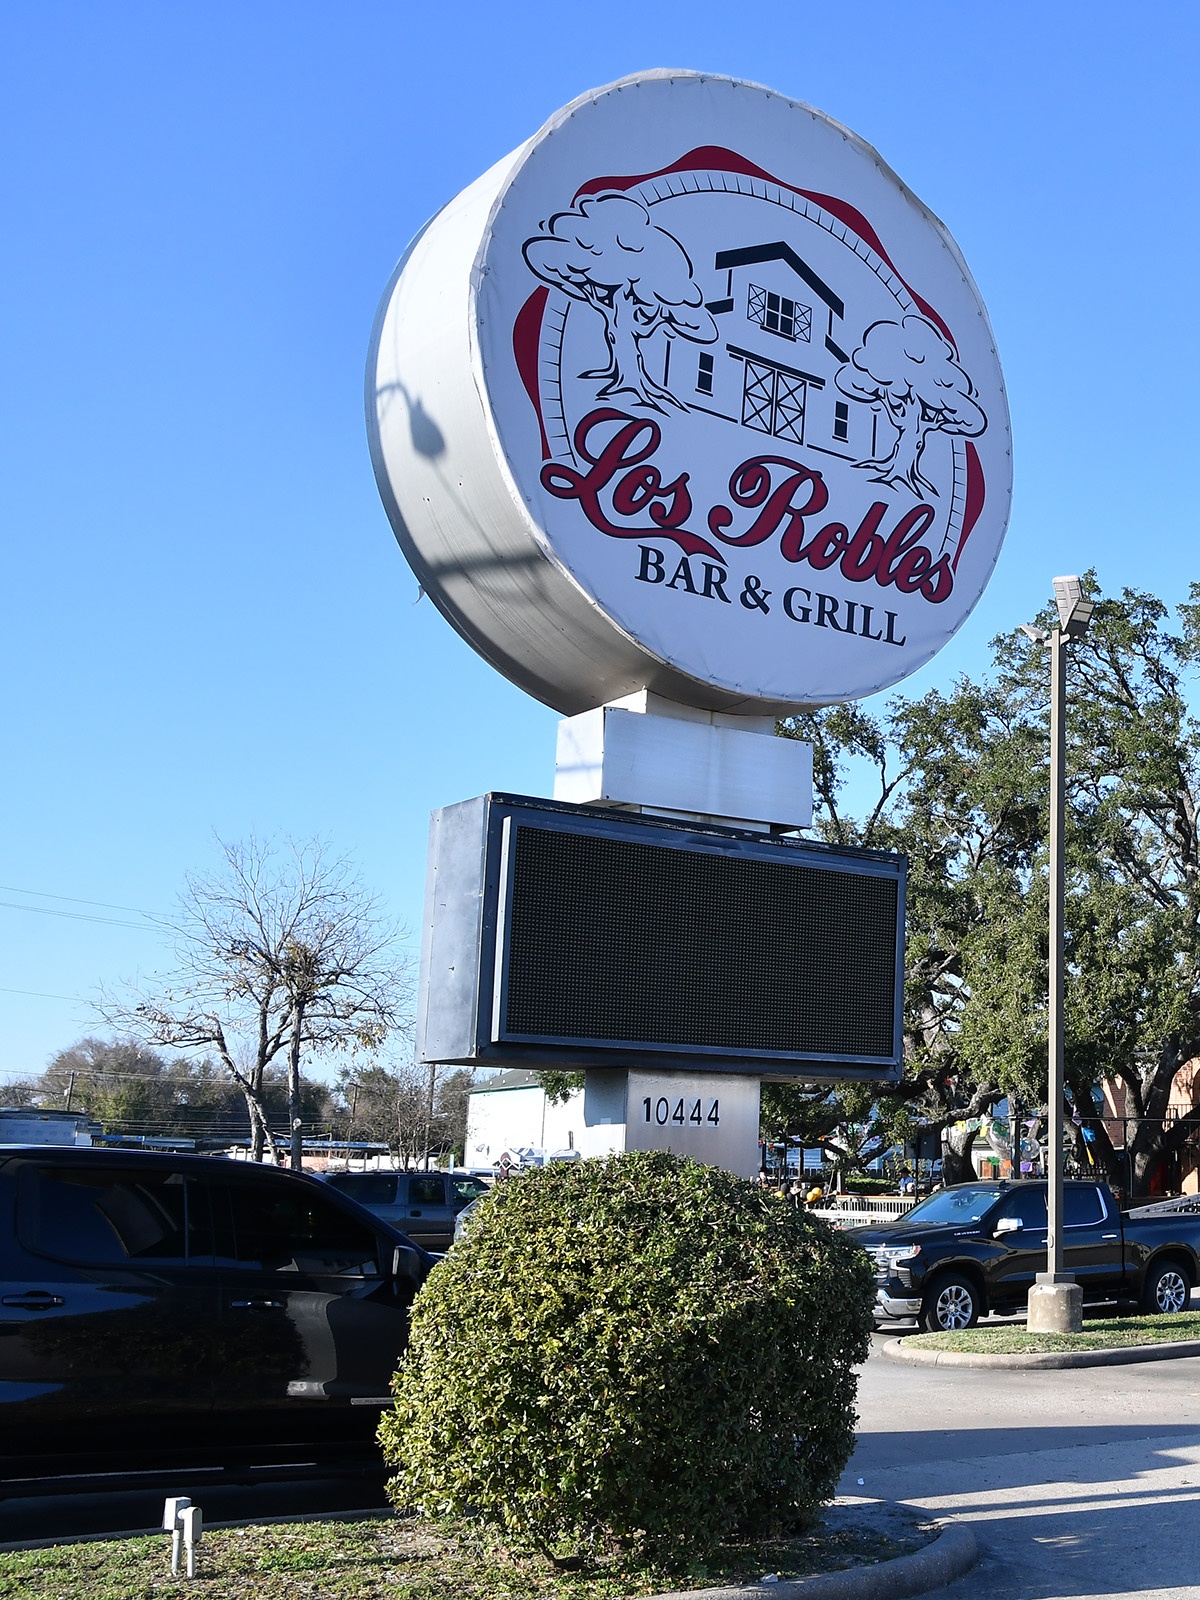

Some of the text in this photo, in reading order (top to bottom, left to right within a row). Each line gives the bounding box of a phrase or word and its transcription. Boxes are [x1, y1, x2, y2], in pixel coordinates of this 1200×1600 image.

[540, 408, 955, 603] Los Robles
[634, 544, 907, 647] BAR & GRILL
[643, 1097, 720, 1126] 10444
